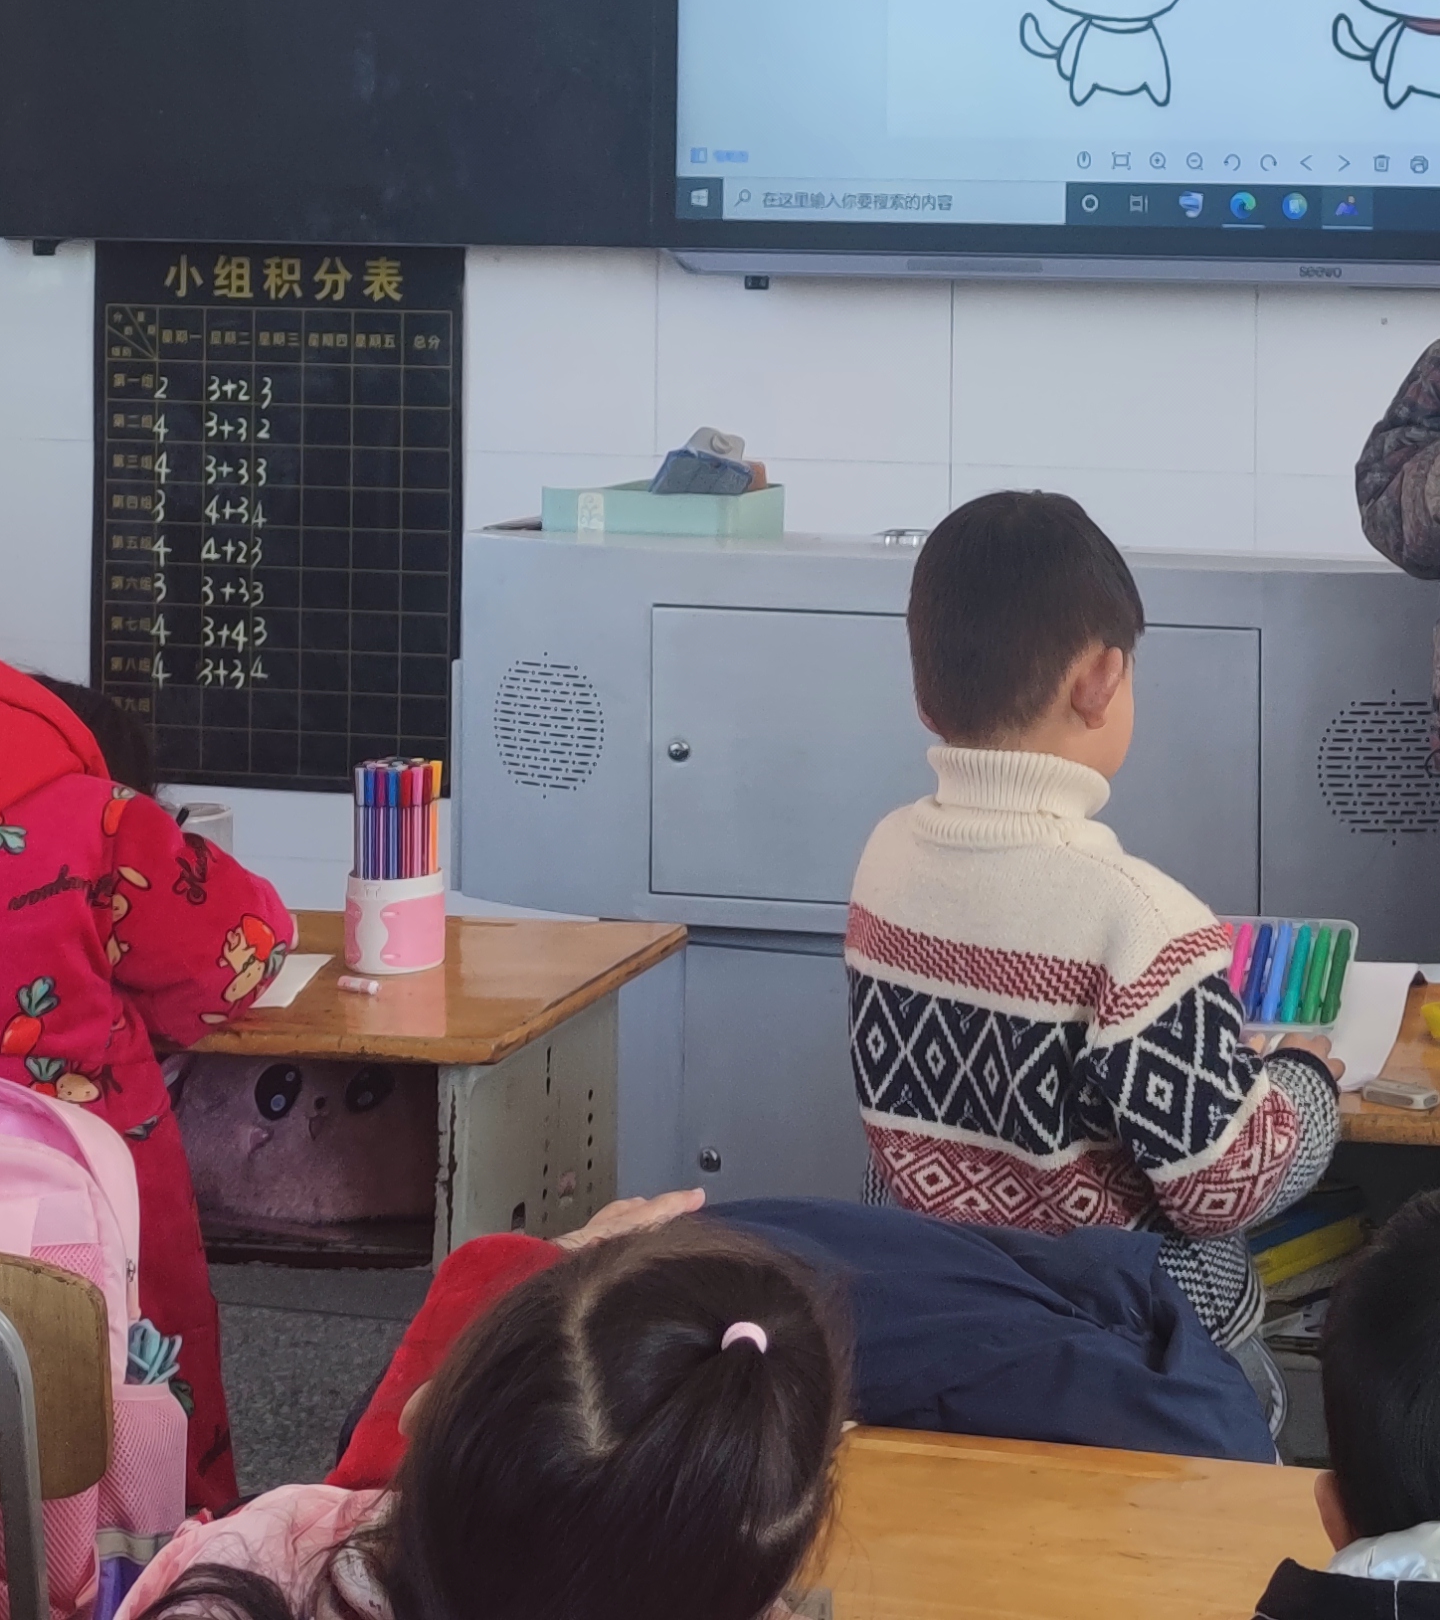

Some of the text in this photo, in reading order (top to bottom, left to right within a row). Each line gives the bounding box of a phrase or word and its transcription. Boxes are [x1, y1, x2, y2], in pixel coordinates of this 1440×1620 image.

[164, 254, 404, 302] 小组积分表
[154, 376, 169, 399] 2
[261, 376, 273, 410] 3
[152, 414, 169, 443] 4
[257, 418, 270, 439] 2
[154, 451, 171, 484] 4
[256, 458, 267, 487] 3
[152, 489, 166, 522] 3
[251, 500, 268, 528] 4
[151, 535, 172, 568] 4
[251, 536, 263, 569] 3
[153, 572, 167, 603] 3
[250, 581, 264, 608] 3
[150, 613, 172, 646] 4
[253, 616, 268, 646] 3
[151, 651, 172, 691] 4
[250, 655, 269, 679] 4
